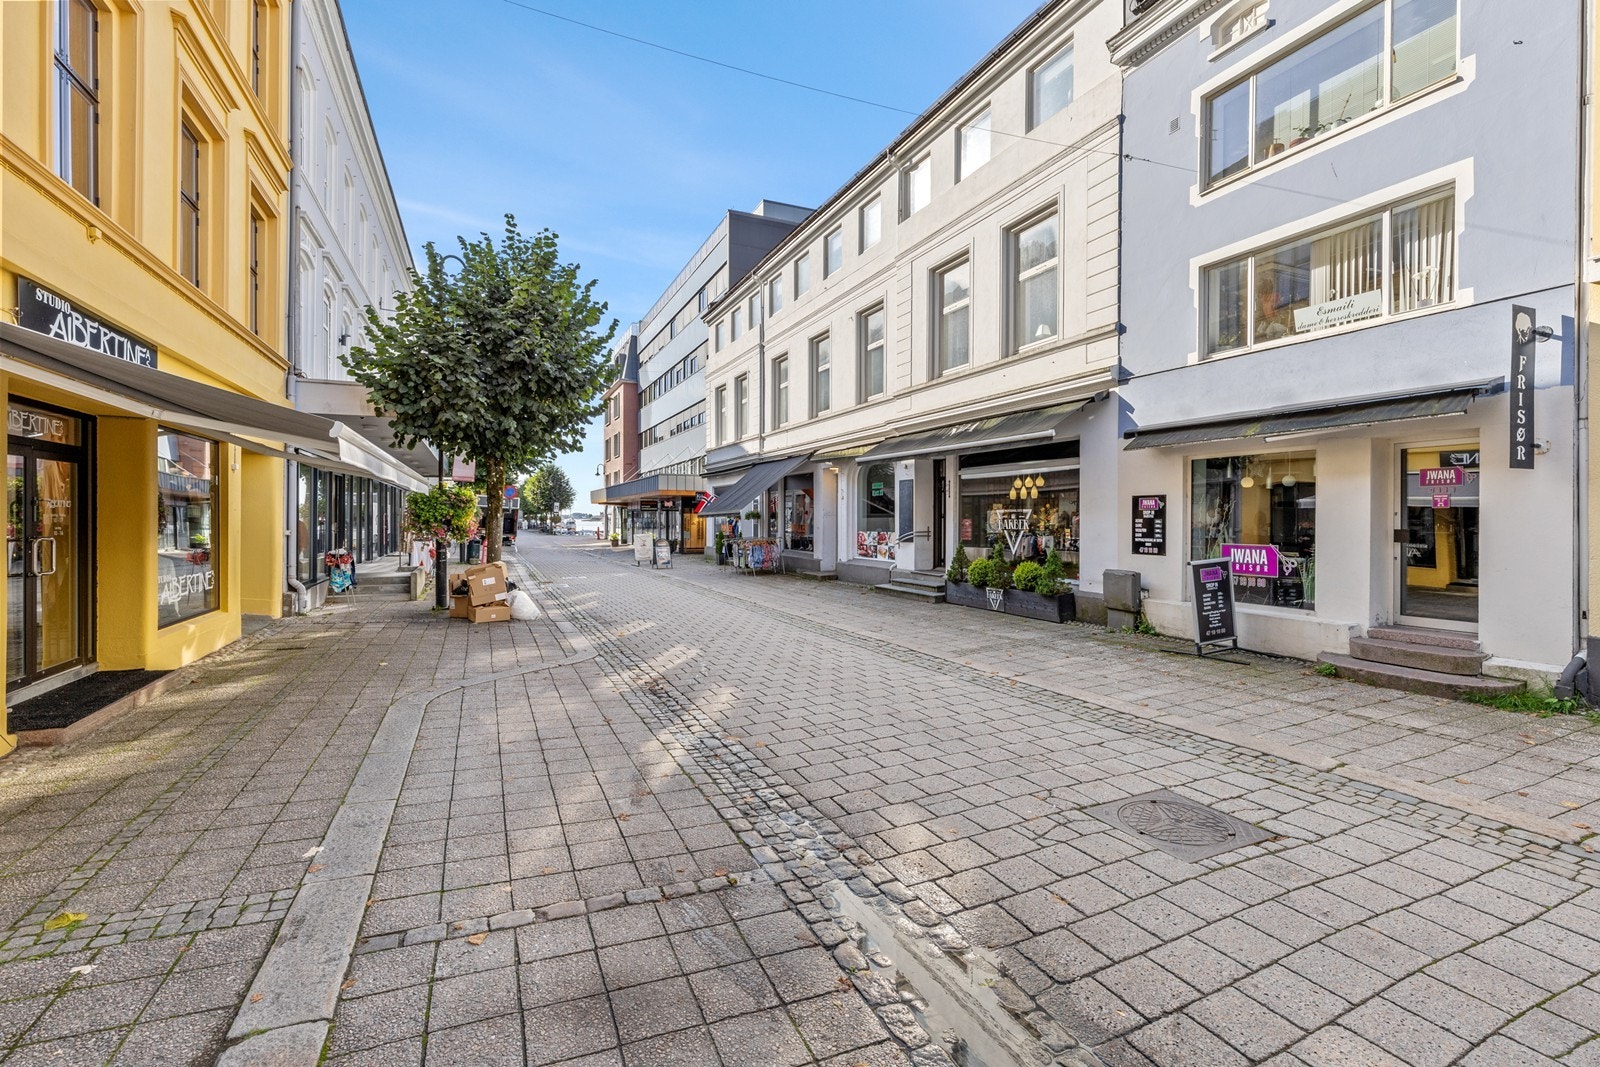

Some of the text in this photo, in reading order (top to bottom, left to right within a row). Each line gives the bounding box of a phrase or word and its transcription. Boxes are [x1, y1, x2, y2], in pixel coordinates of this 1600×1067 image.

[35, 287, 71, 315] STUDIO
[1516, 355, 1528, 461] FRISØR
[1426, 469, 1456, 480] JWANA
[1231, 548, 1268, 565] JWANA
[1235, 564, 1269, 573] RISØR
